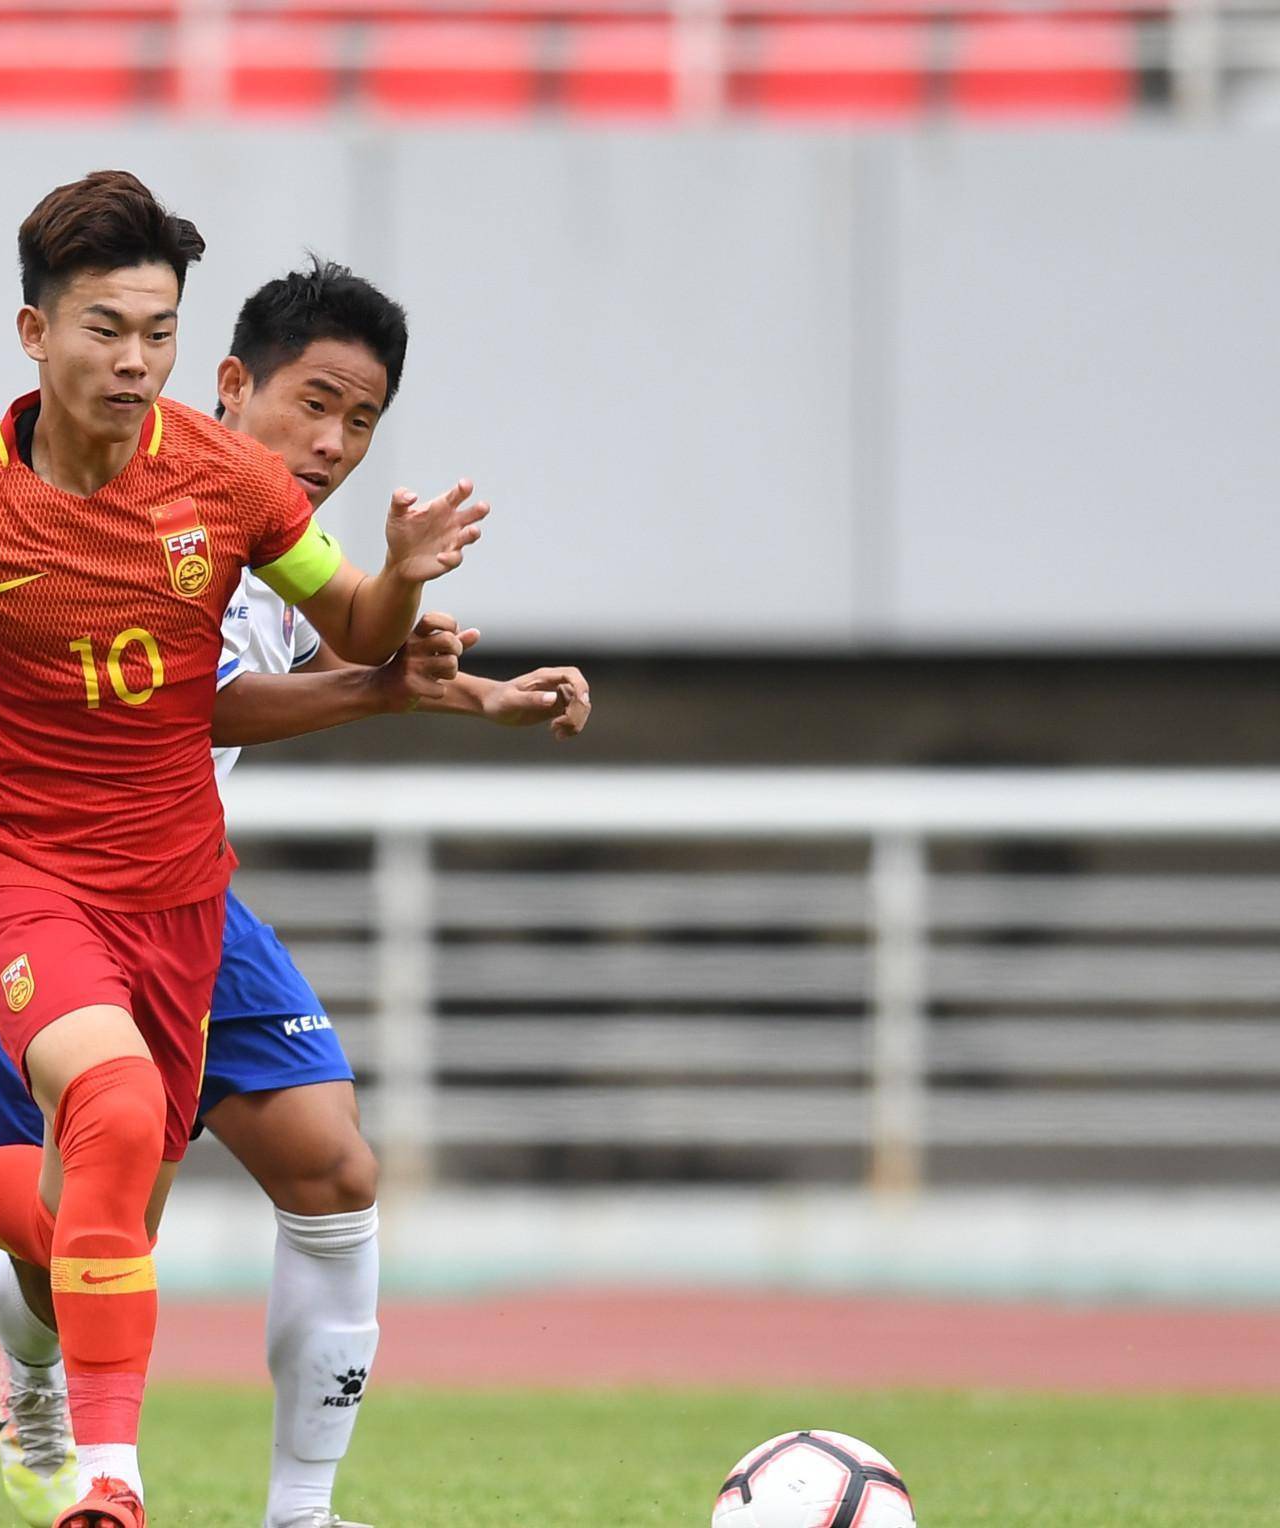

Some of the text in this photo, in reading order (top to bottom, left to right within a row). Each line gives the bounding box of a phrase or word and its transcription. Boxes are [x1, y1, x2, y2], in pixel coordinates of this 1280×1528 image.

[167, 529, 205, 552] CFA
[69, 627, 164, 709] 10
[2, 957, 26, 984] CFA
